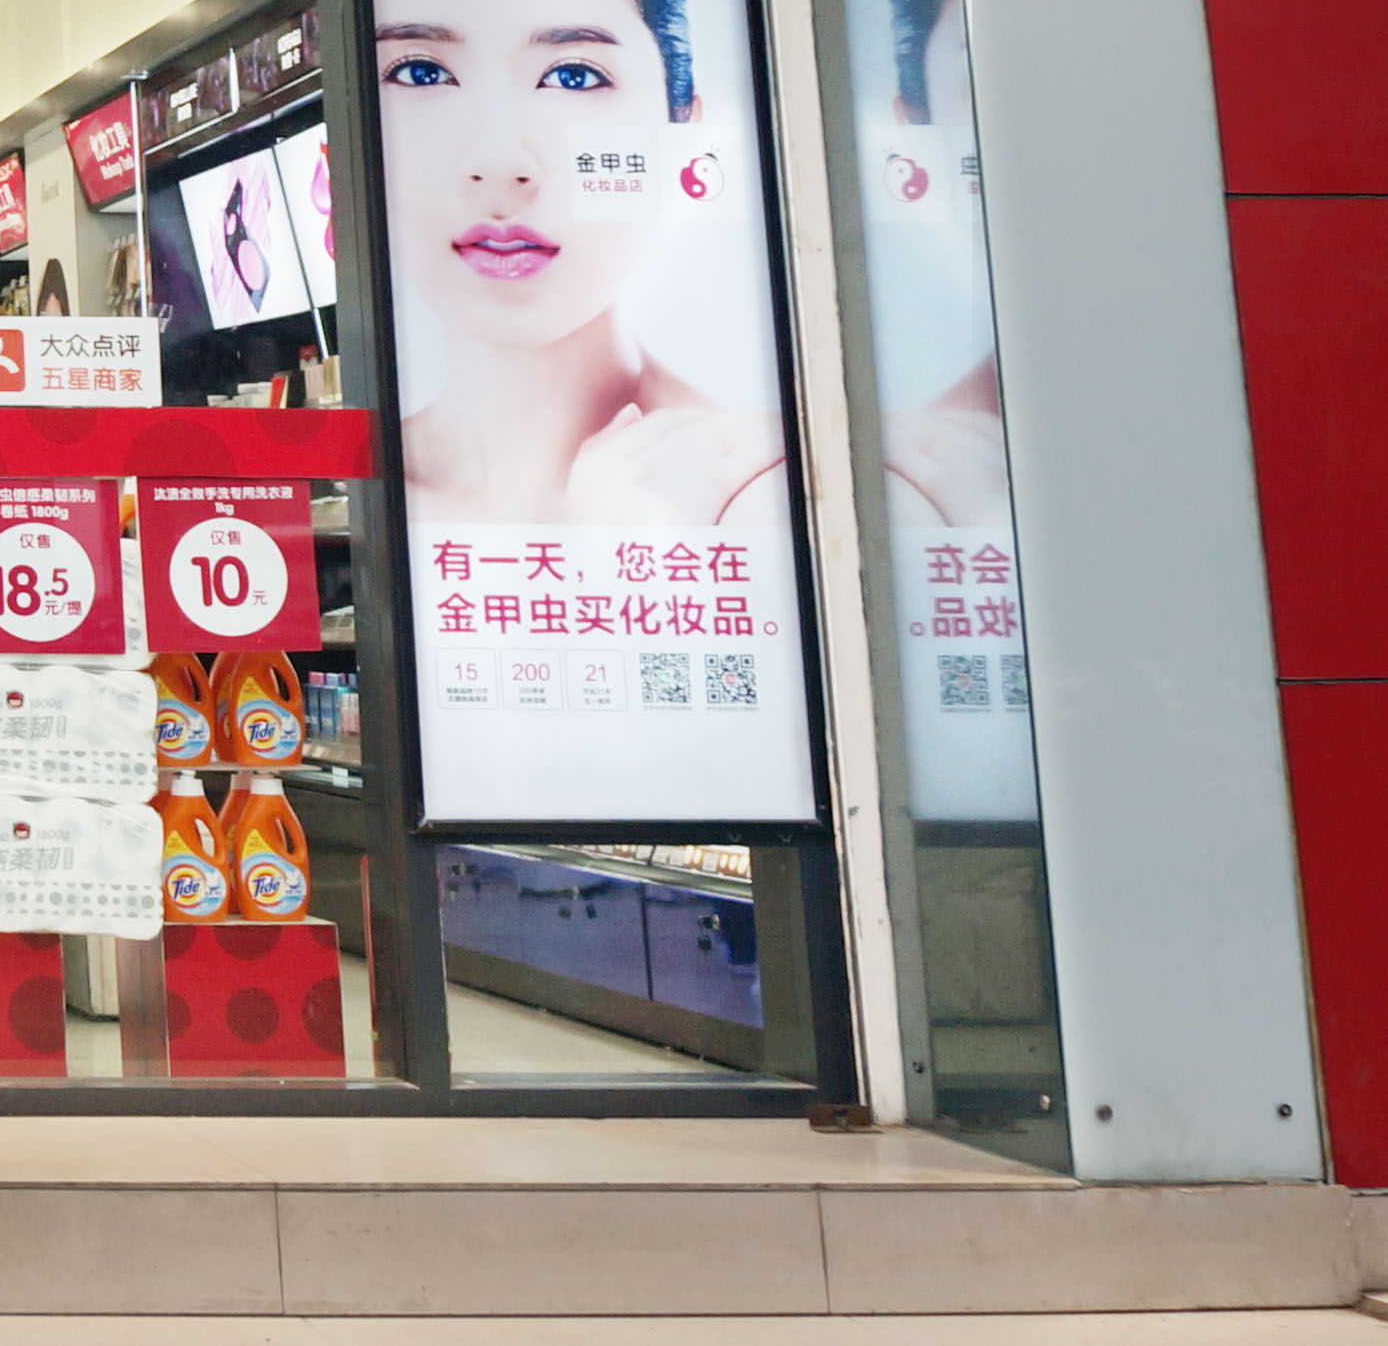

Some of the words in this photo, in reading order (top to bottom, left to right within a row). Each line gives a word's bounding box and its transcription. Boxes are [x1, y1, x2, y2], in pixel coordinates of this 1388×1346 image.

[575, 152, 647, 174] 金甲虫
[582, 179, 643, 193] 化妆品店
[40, 333, 141, 358] 大众点评
[42, 367, 143, 392] 五星商家
[31, 505, 69, 520] 1800g
[20, 533, 51, 549] 仅售
[210, 530, 242, 546] 仅售
[191, 555, 250, 607] 10
[253, 591, 268, 606] 元
[454, 662, 478, 681] 15
[512, 663, 551, 682] 200
[585, 664, 607, 682] 21
[156, 722, 184, 744] Tide
[248, 721, 275, 744] Tide
[171, 877, 200, 900] Tide
[252, 876, 280, 899] Tide
